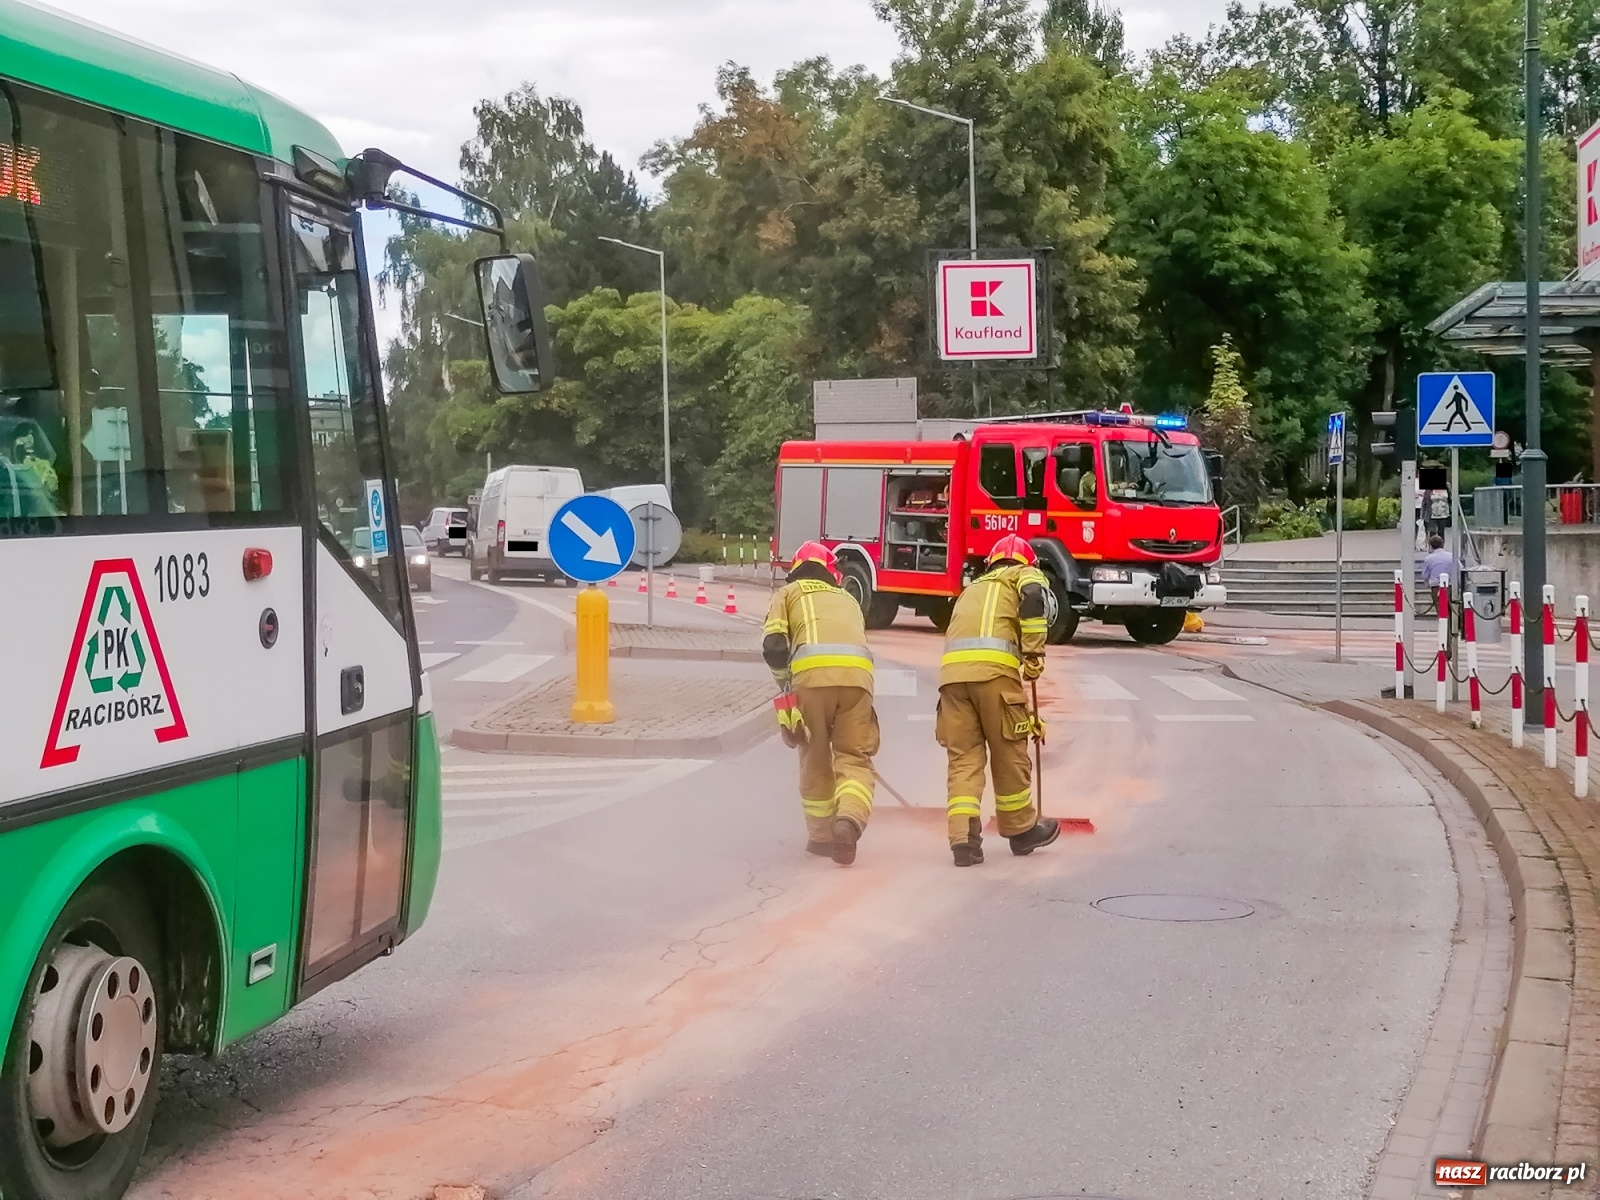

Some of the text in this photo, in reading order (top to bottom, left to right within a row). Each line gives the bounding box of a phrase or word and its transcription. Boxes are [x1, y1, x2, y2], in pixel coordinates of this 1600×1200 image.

[955, 326, 1022, 339] Kaufland
[154, 552, 210, 602] 1083
[104, 627, 129, 670] PK
[65, 693, 165, 731] RACIBÓRZ
